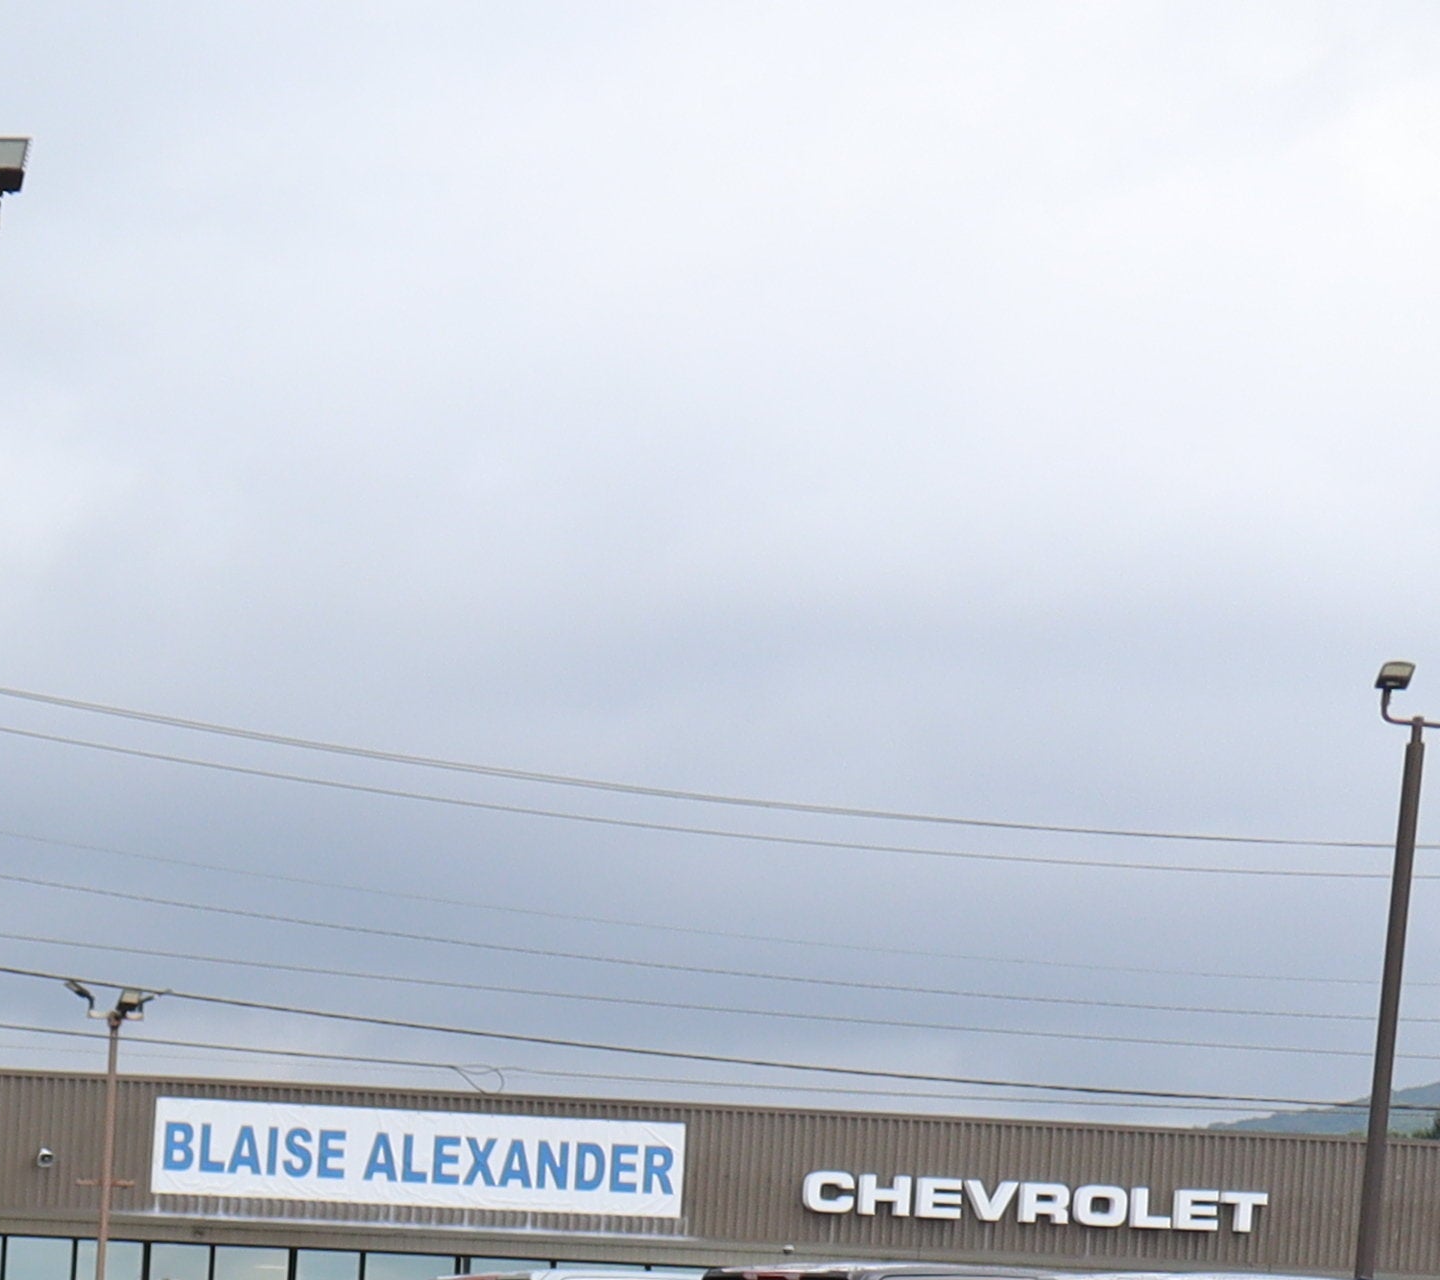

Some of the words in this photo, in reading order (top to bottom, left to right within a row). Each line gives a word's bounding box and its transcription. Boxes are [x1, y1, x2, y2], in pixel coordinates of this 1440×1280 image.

[162, 1121, 347, 1179] BLAISE
[363, 1132, 674, 1195] ALEXANDER
[802, 1171, 1269, 1233] CHEVROLET
